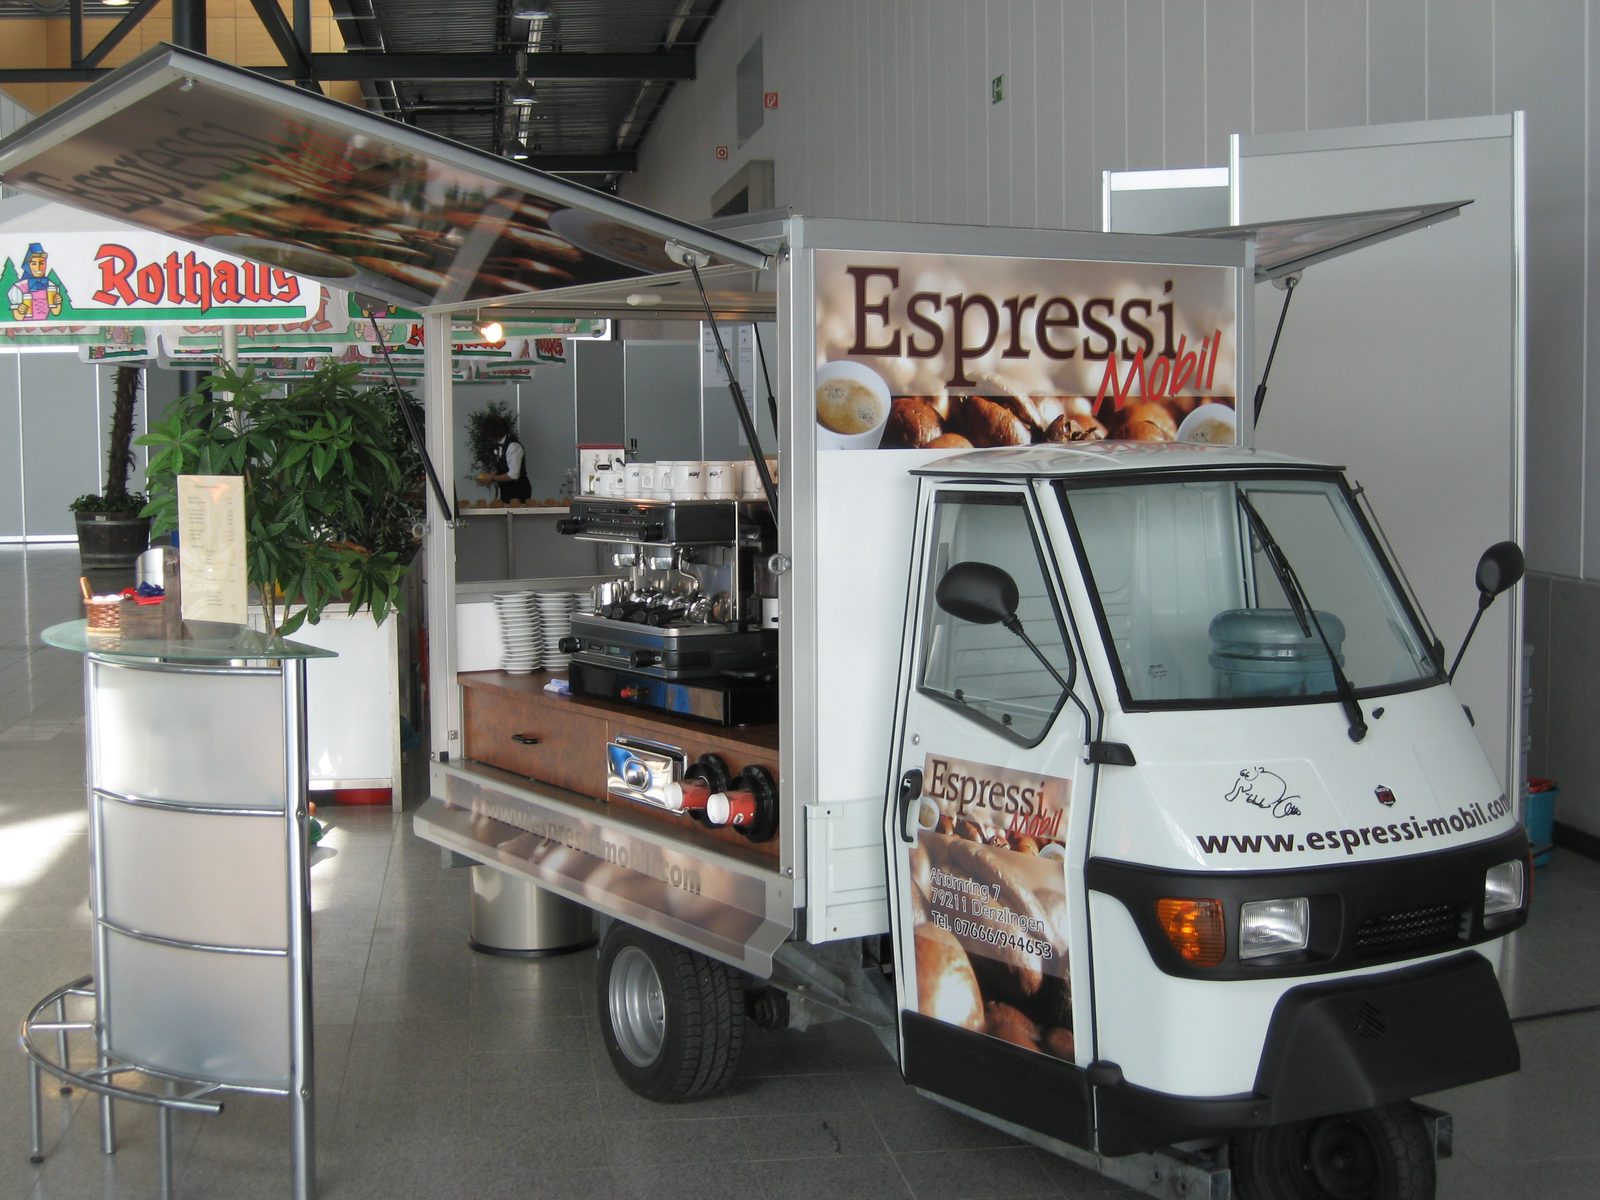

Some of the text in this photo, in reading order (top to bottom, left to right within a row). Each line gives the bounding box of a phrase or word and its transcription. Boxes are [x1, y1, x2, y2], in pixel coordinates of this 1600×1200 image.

[92, 243, 302, 316] Rothaus
[846, 265, 1180, 389] Espressi
[1092, 329, 1222, 416] Mobil
[929, 759, 1045, 821] Espressi
[1006, 807, 1064, 837] Mobil
[1196, 793, 1511, 855] www.espressi-mobil.com
[929, 867, 1001, 903] Ahornring 7
[931, 887, 1045, 933] 79211 Denzlingen
[931, 910, 1053, 959] Tel. 07666/944653
